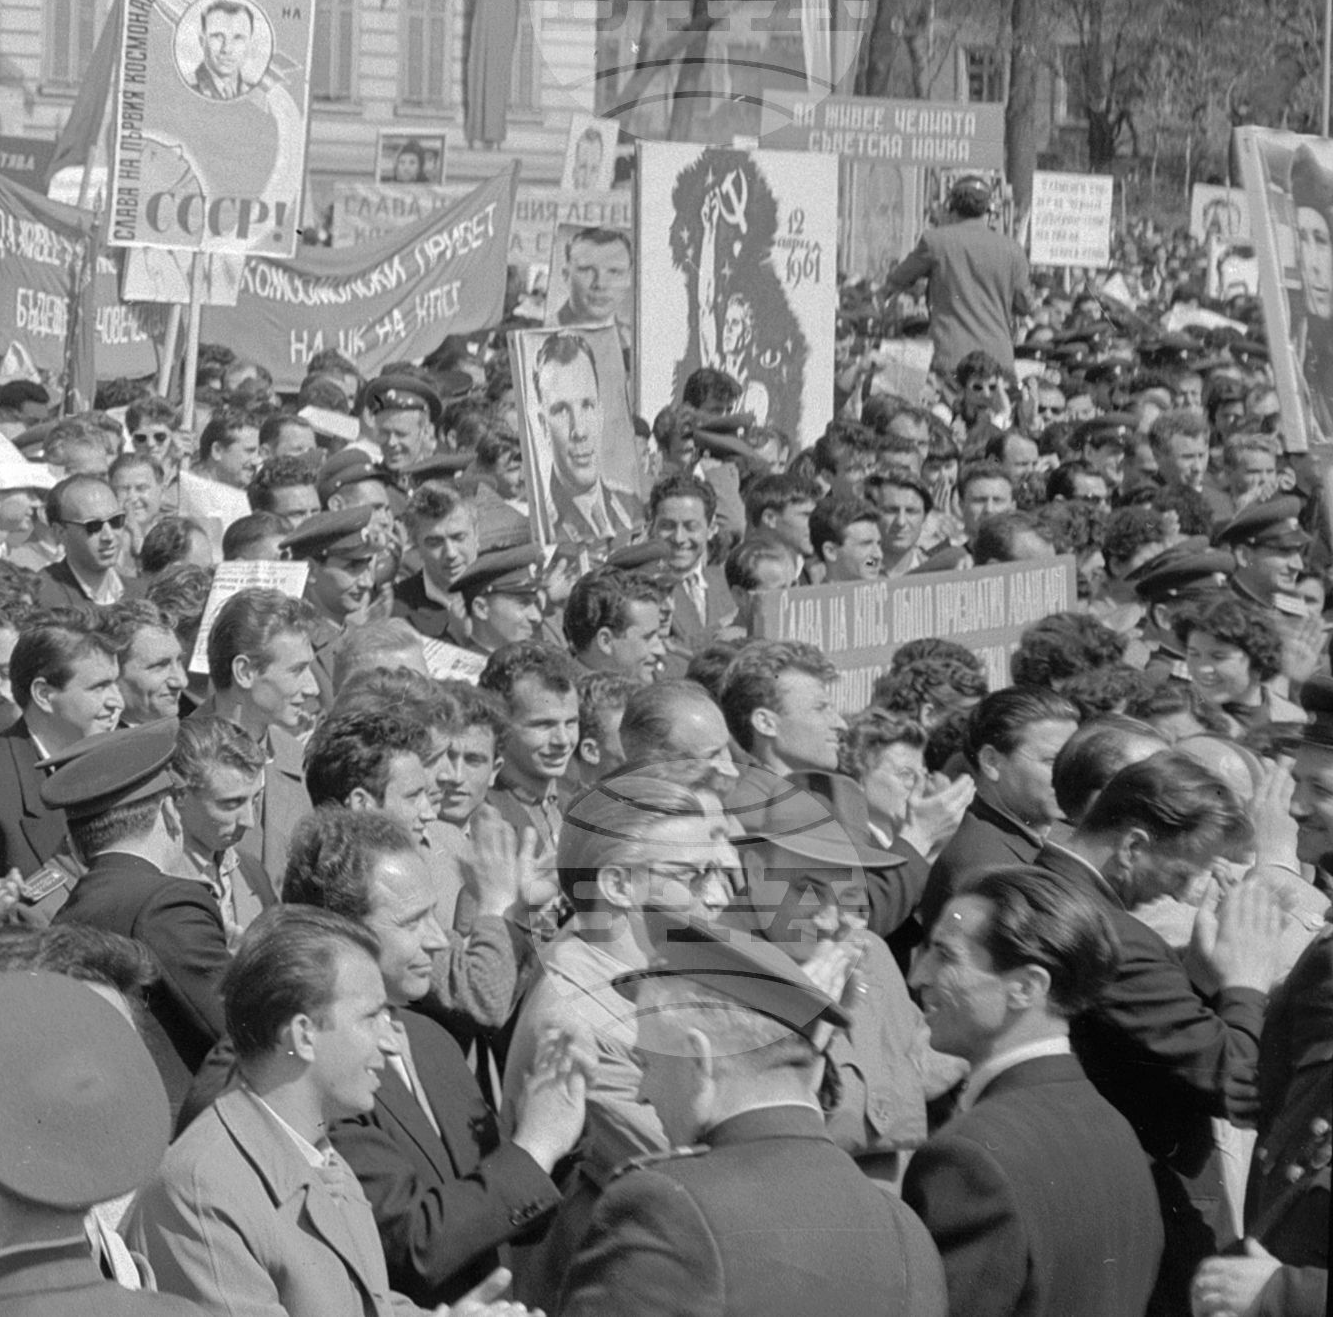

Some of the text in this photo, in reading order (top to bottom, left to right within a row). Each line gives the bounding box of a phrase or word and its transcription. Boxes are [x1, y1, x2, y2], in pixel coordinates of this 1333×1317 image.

[282, 8, 302, 20] НА
[120, 90, 145, 151] ПЪРВИЯ
[825, 103, 884, 130] ЖИВЕЕ
[119, 158, 141, 181] НА
[809, 131, 970, 162] СЪВЕТСКА НАУКА
[113, 188, 140, 241] СЛАВА
[145, 191, 287, 243] СССР!
[788, 208, 805, 235] 12
[785, 243, 822, 289] 1961
[290, 330, 324, 364] НА
[375, 307, 406, 345] НА
[829, 596, 847, 651] НА
[854, 582, 888, 648] КПСС
